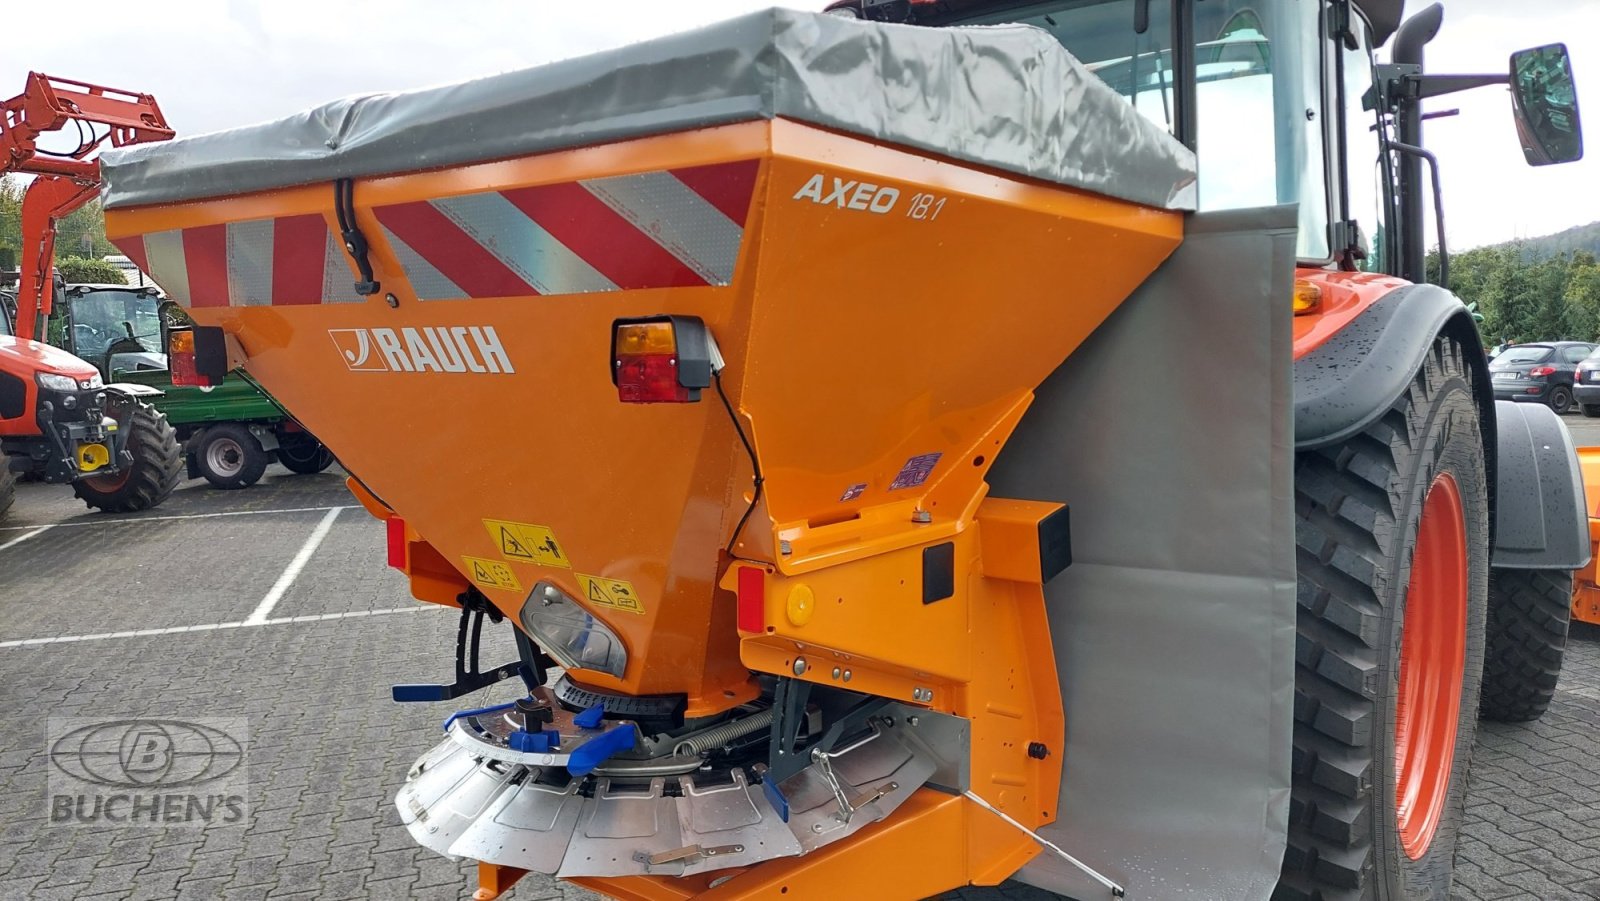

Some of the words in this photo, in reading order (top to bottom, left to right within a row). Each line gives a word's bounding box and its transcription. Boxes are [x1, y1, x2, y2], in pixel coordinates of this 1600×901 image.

[793, 173, 900, 213] AXEO
[907, 192, 947, 221] 18.1
[371, 326, 515, 373] RAUCH
